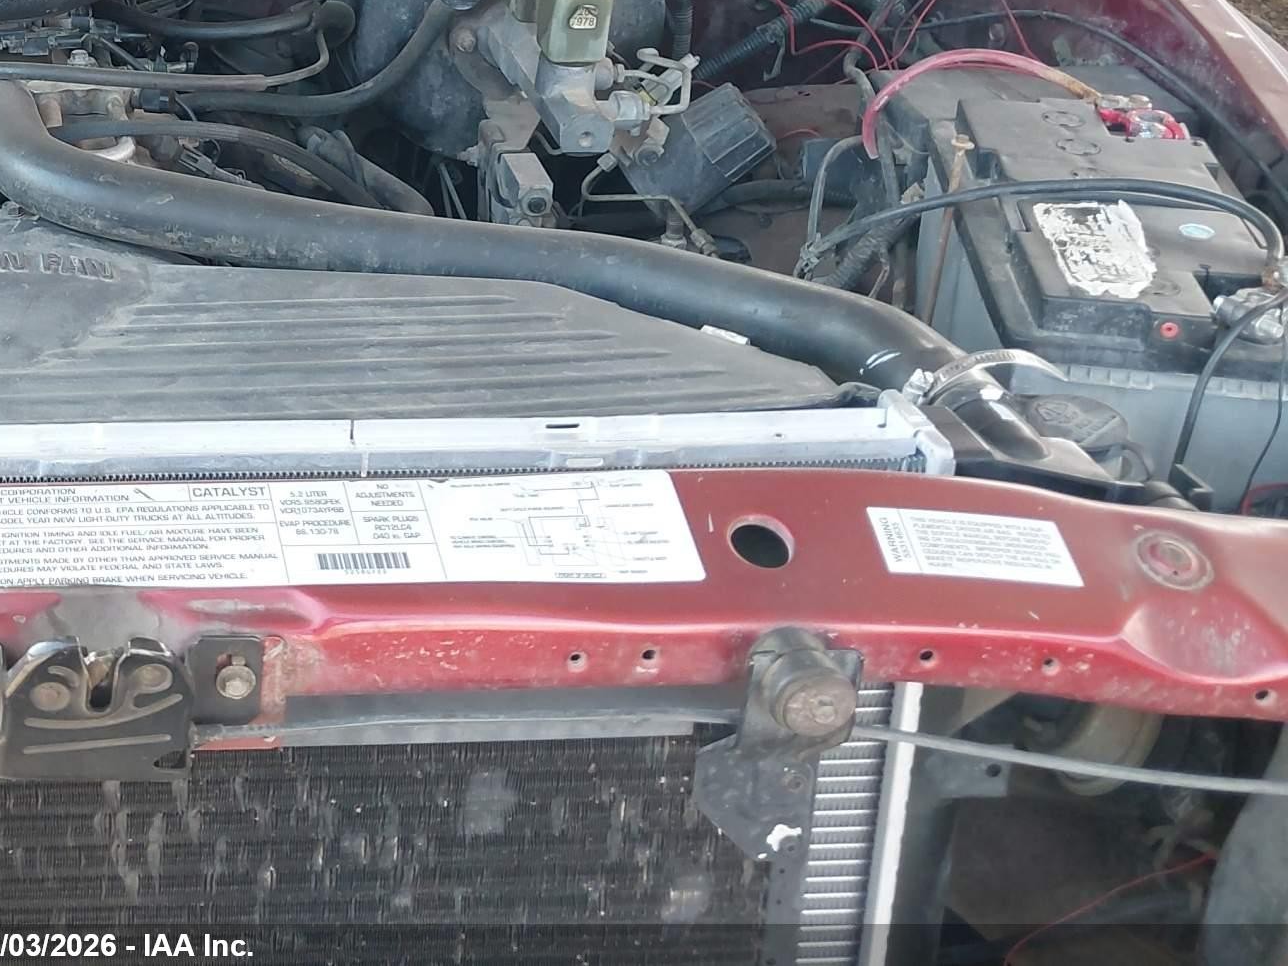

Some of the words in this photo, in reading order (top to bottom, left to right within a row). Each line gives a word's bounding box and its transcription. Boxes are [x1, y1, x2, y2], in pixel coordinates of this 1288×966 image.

[40, 252, 115, 282] FAN
[0, 488, 76, 496] CORPORATION
[192, 486, 266, 498] CATALYST
[306, 490, 328, 498] LITER
[8, 496, 50, 504] VEHICLE
[55, 494, 130, 503] INFORMATION
[95, 506, 111, 514] U.S.
[201, 504, 254, 512] APPLICABLE
[54, 516, 75, 524] NEW
[879, 517, 903, 563] WARNING
[238, 552, 278, 560] MANUAL
[17, 577, 46, 585] APPLY
[48, 576, 90, 585] PARKING
[92, 576, 123, 584] BRAKE
[126, 574, 154, 582] WHEN
[158, 573, 206, 581] SERVICING
